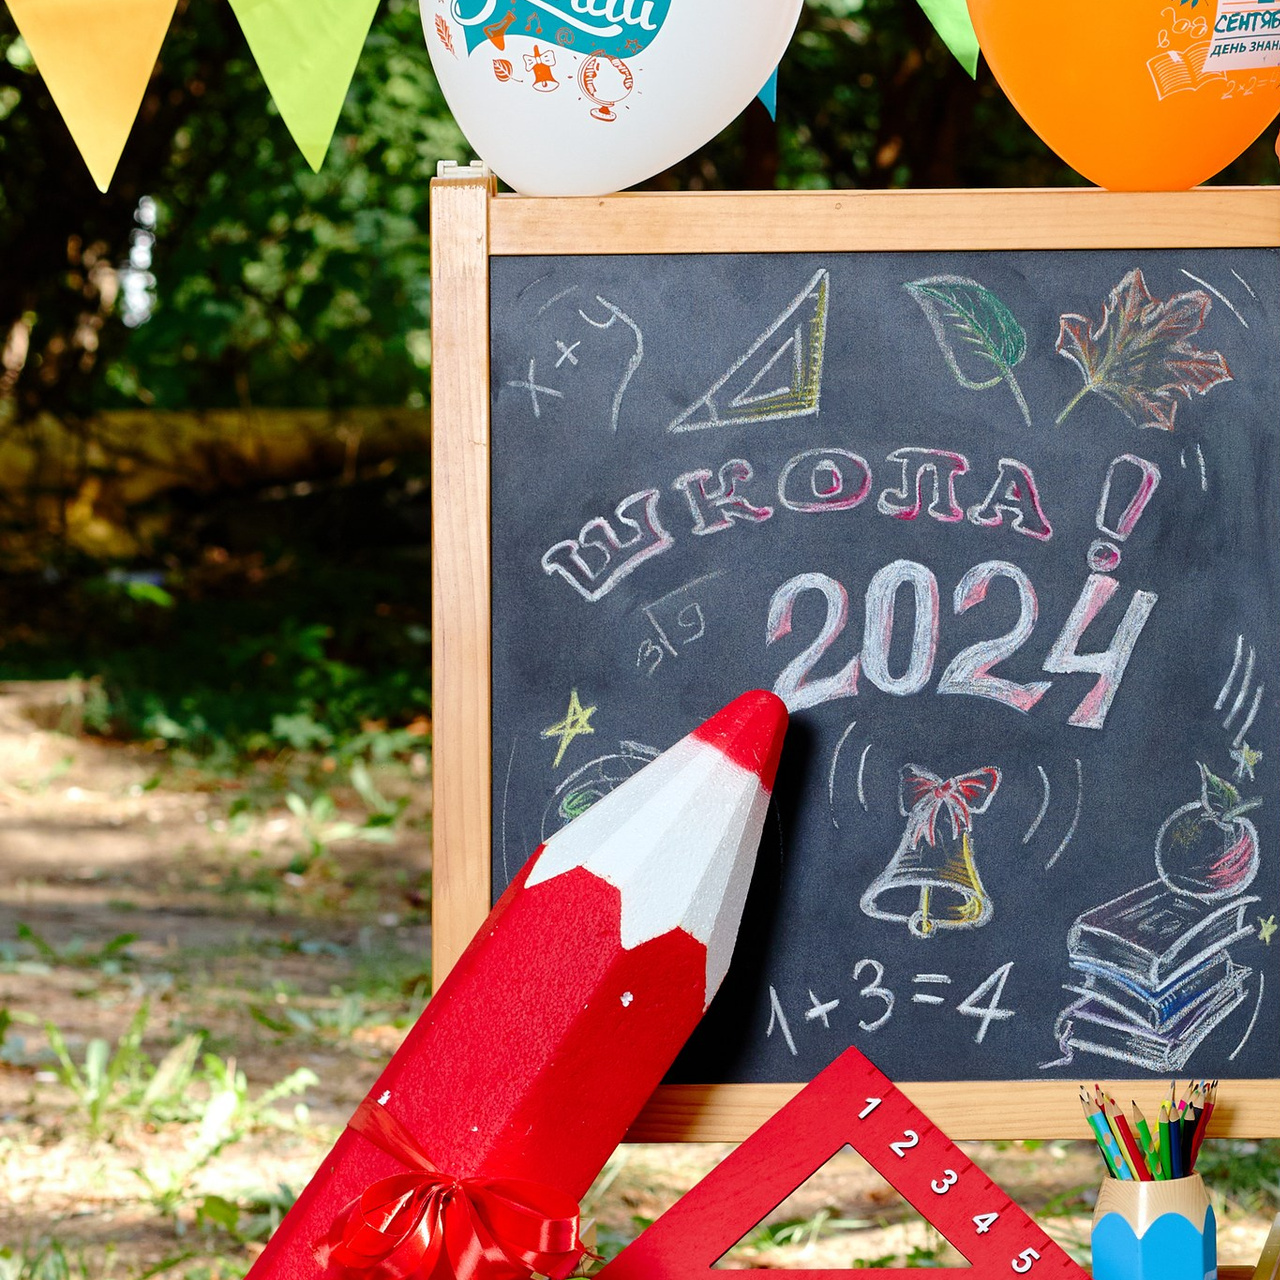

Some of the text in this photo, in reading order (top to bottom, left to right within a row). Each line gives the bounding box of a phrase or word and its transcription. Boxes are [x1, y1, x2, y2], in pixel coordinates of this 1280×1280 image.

[1209, 42, 1247, 58] ДЕНЬ
[764, 558, 1159, 731] 2024
[858, 1097, 882, 1120] 1
[888, 1130, 919, 1158] 2
[931, 1169, 958, 1194] 3
[972, 1211, 1000, 1235] 4
[1011, 1247, 1040, 1274] 5
